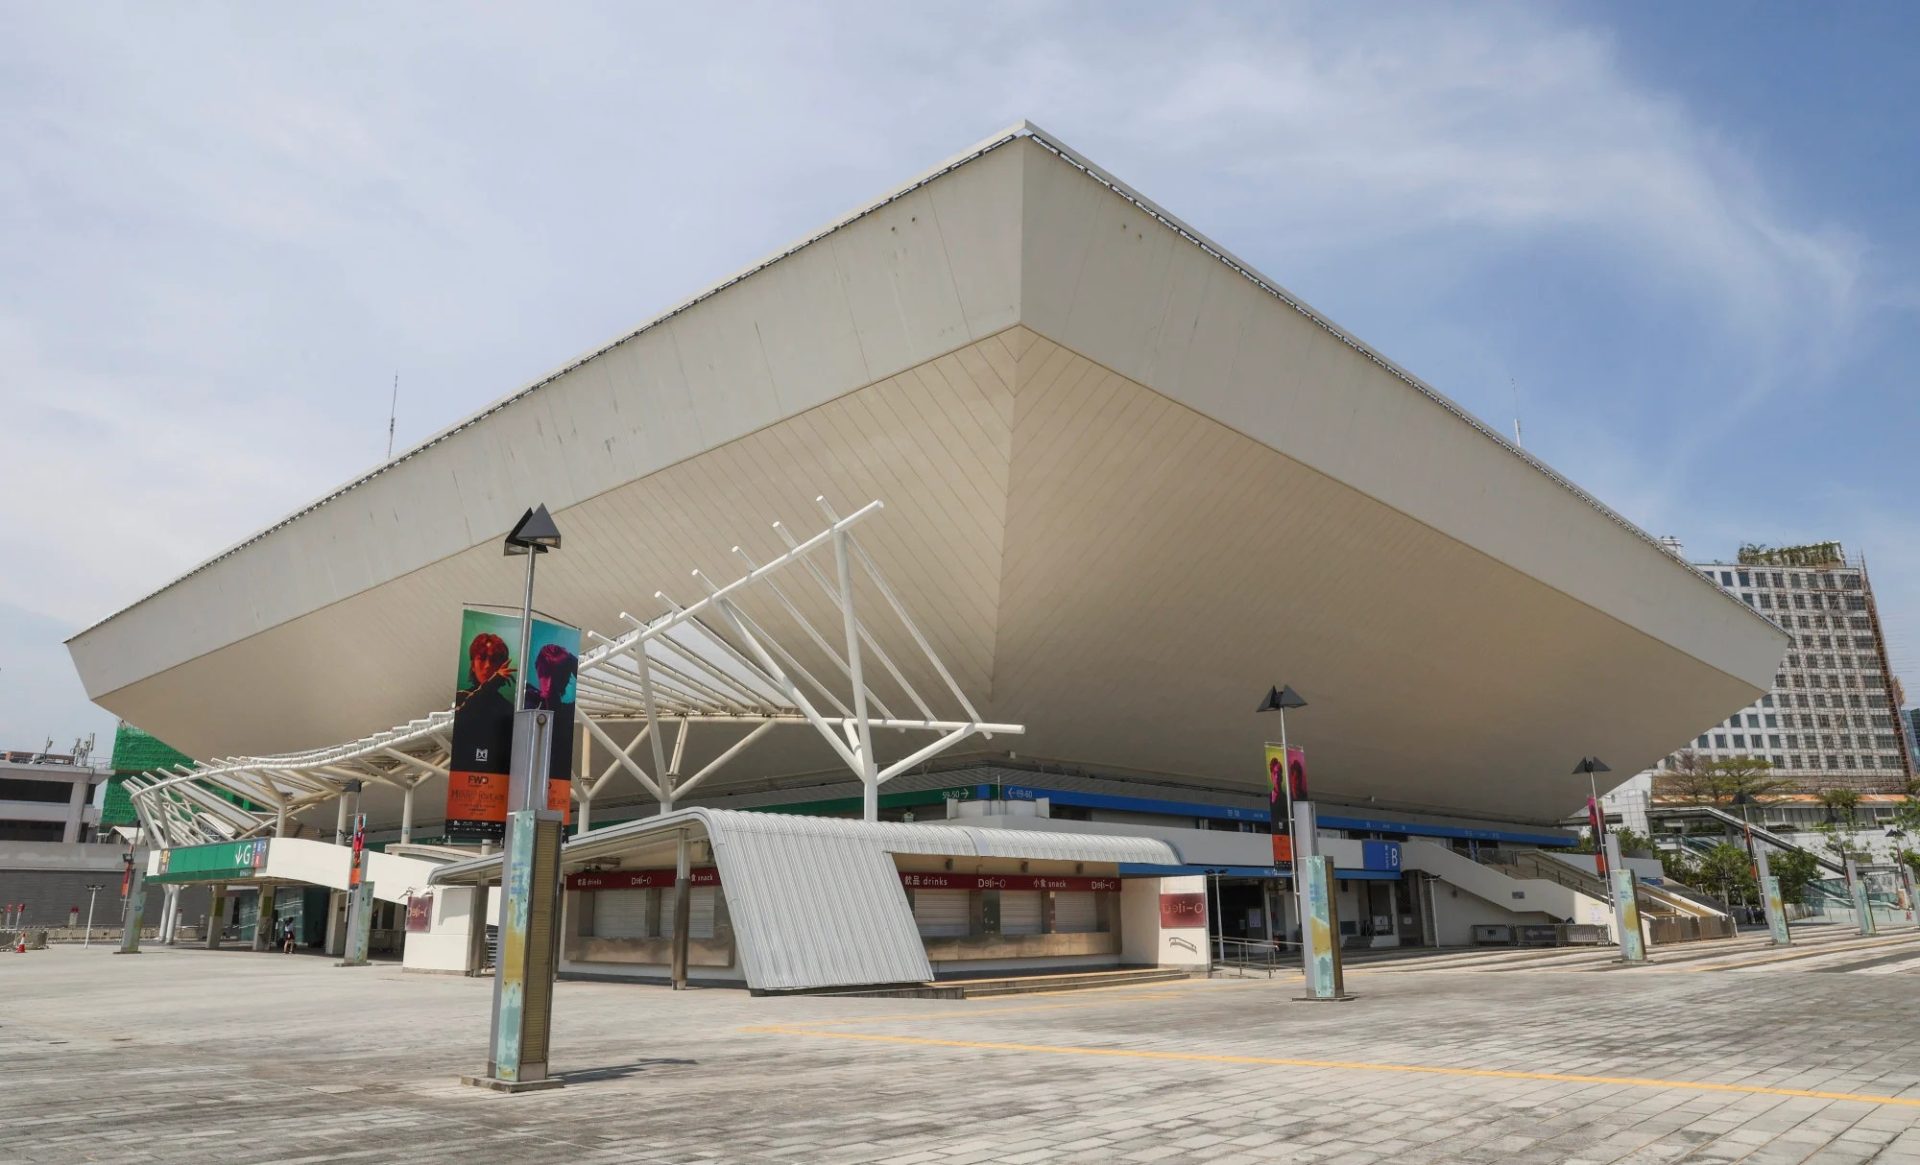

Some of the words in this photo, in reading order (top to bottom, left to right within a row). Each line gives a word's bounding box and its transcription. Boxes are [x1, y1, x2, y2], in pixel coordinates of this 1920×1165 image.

[467, 775, 489, 784] FWD
[243, 844, 252, 865] G
[1391, 847, 1398, 867] B
[904, 875, 921, 886] 飲品
[923, 876, 948, 886] drinks
[1033, 879, 1047, 889] 小食
[1047, 880, 1067, 889] snack
